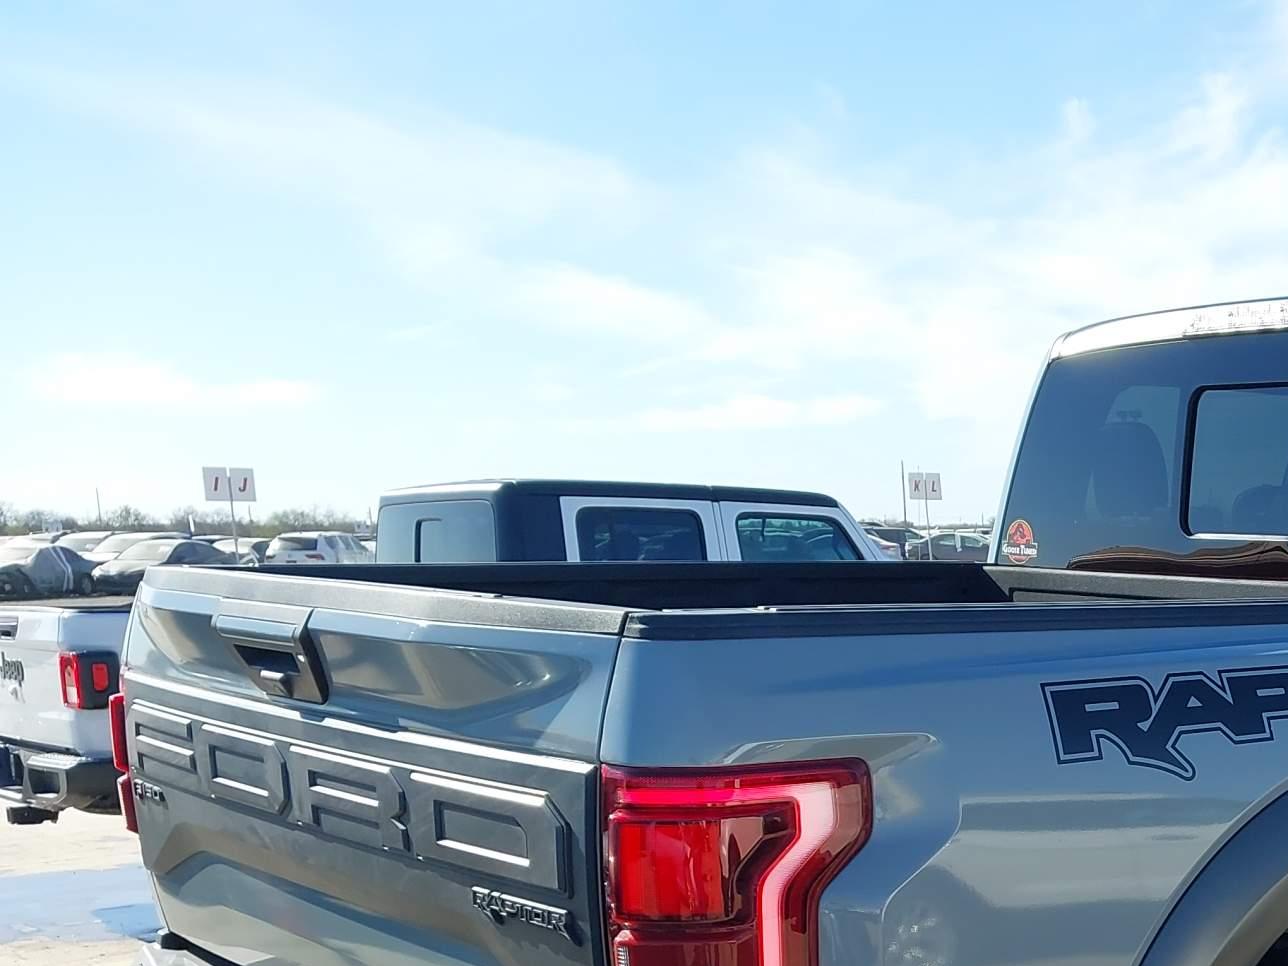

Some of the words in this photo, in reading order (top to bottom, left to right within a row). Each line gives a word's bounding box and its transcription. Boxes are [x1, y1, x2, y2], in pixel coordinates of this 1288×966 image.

[238, 477, 248, 492] J
[914, 480, 921, 492] K
[931, 480, 937, 492] L
[130, 699, 572, 891] FORD
[471, 886, 571, 941] RAPTOR
